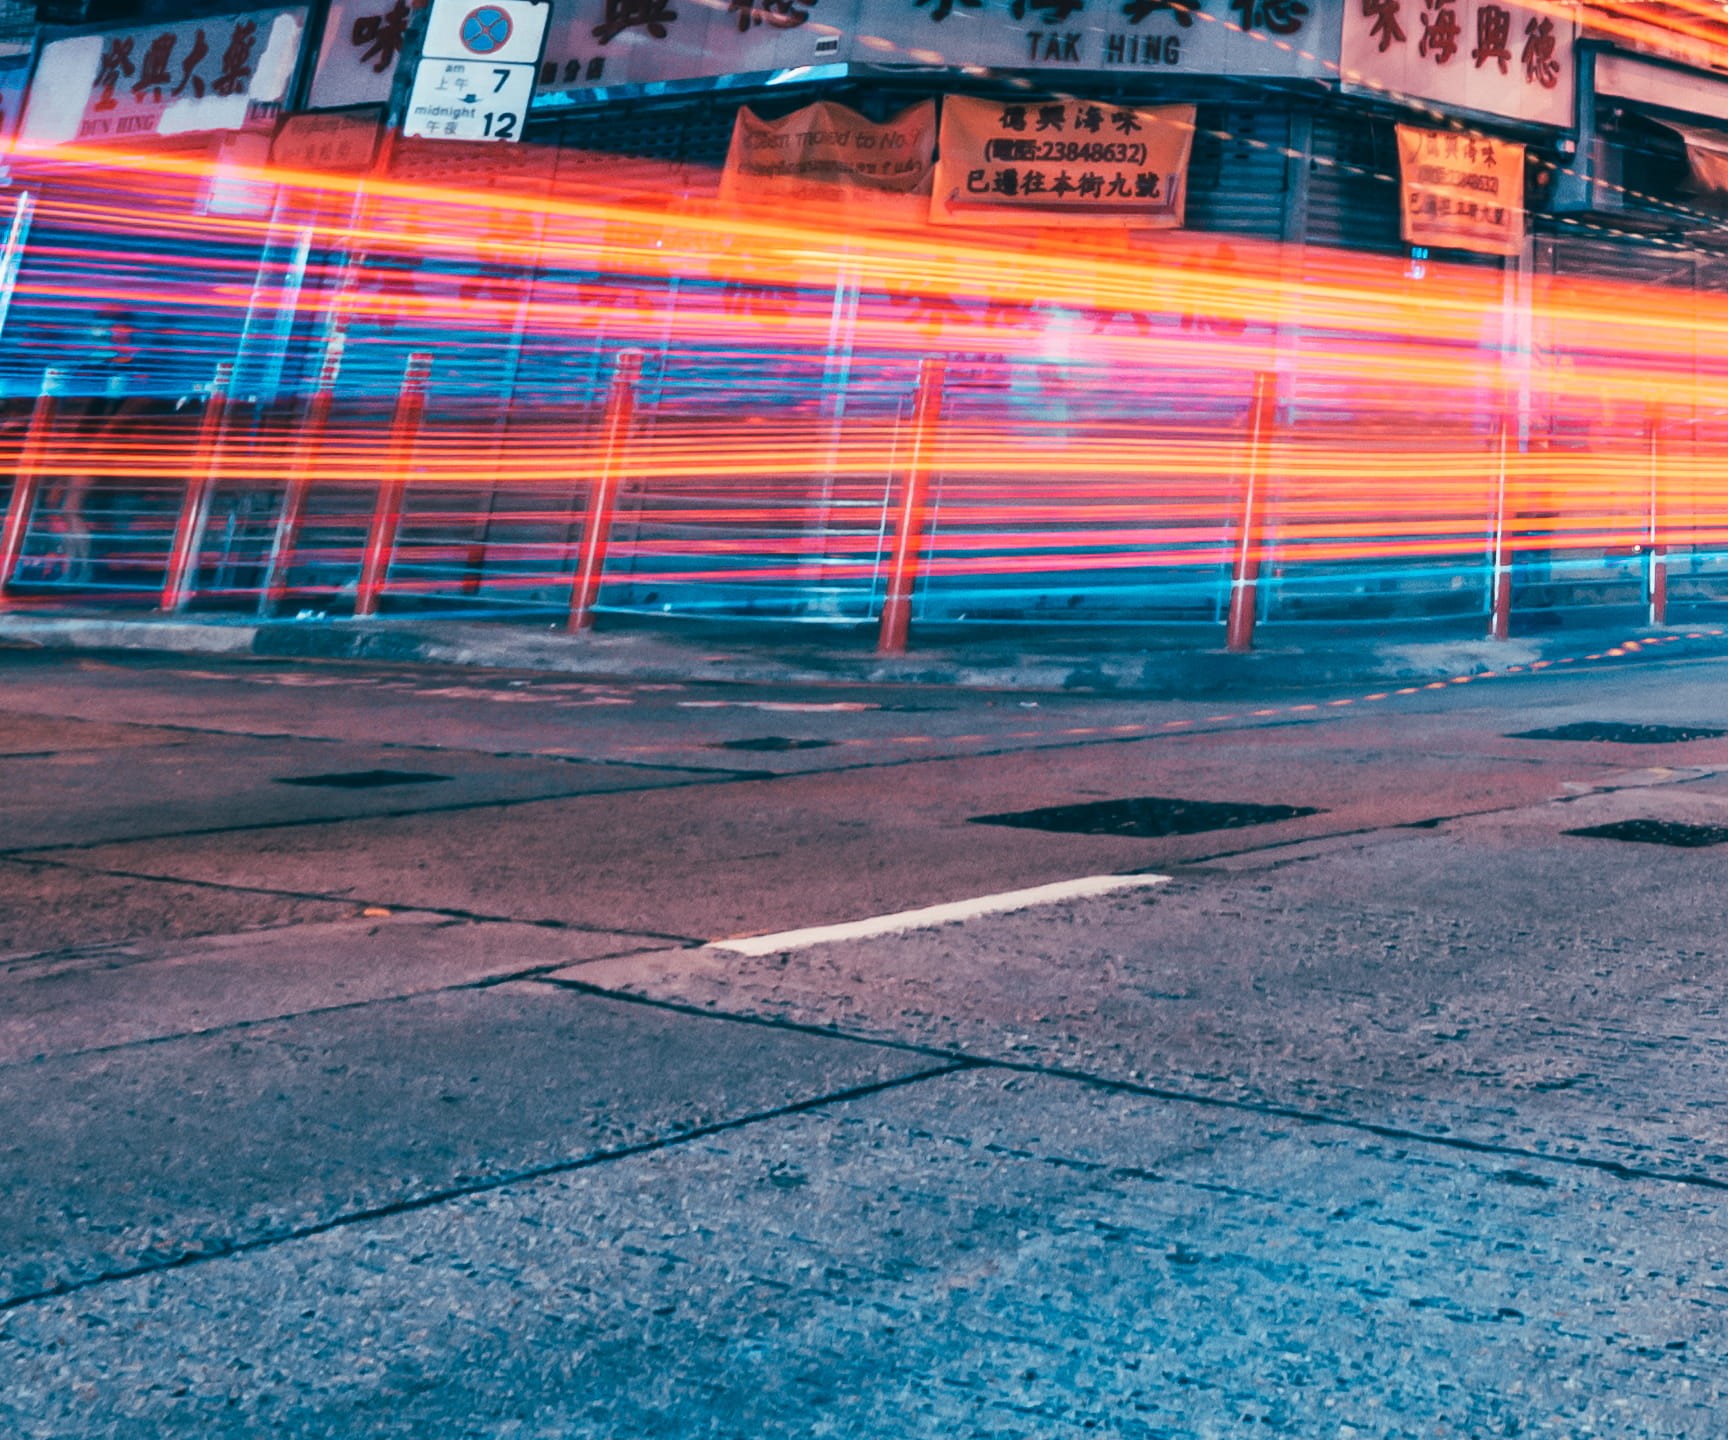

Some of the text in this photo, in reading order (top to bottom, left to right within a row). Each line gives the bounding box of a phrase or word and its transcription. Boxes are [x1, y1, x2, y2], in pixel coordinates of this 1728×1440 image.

[1028, 31, 1181, 65] TAK HING
[435, 76, 469, 92] 上午
[445, 63, 511, 93] am 7
[115, 114, 156, 133] HING
[414, 104, 517, 139] midnight 12
[426, 120, 458, 135] 午夜
[1000, 105, 1142, 136] 德興海味
[856, 132, 875, 149] to
